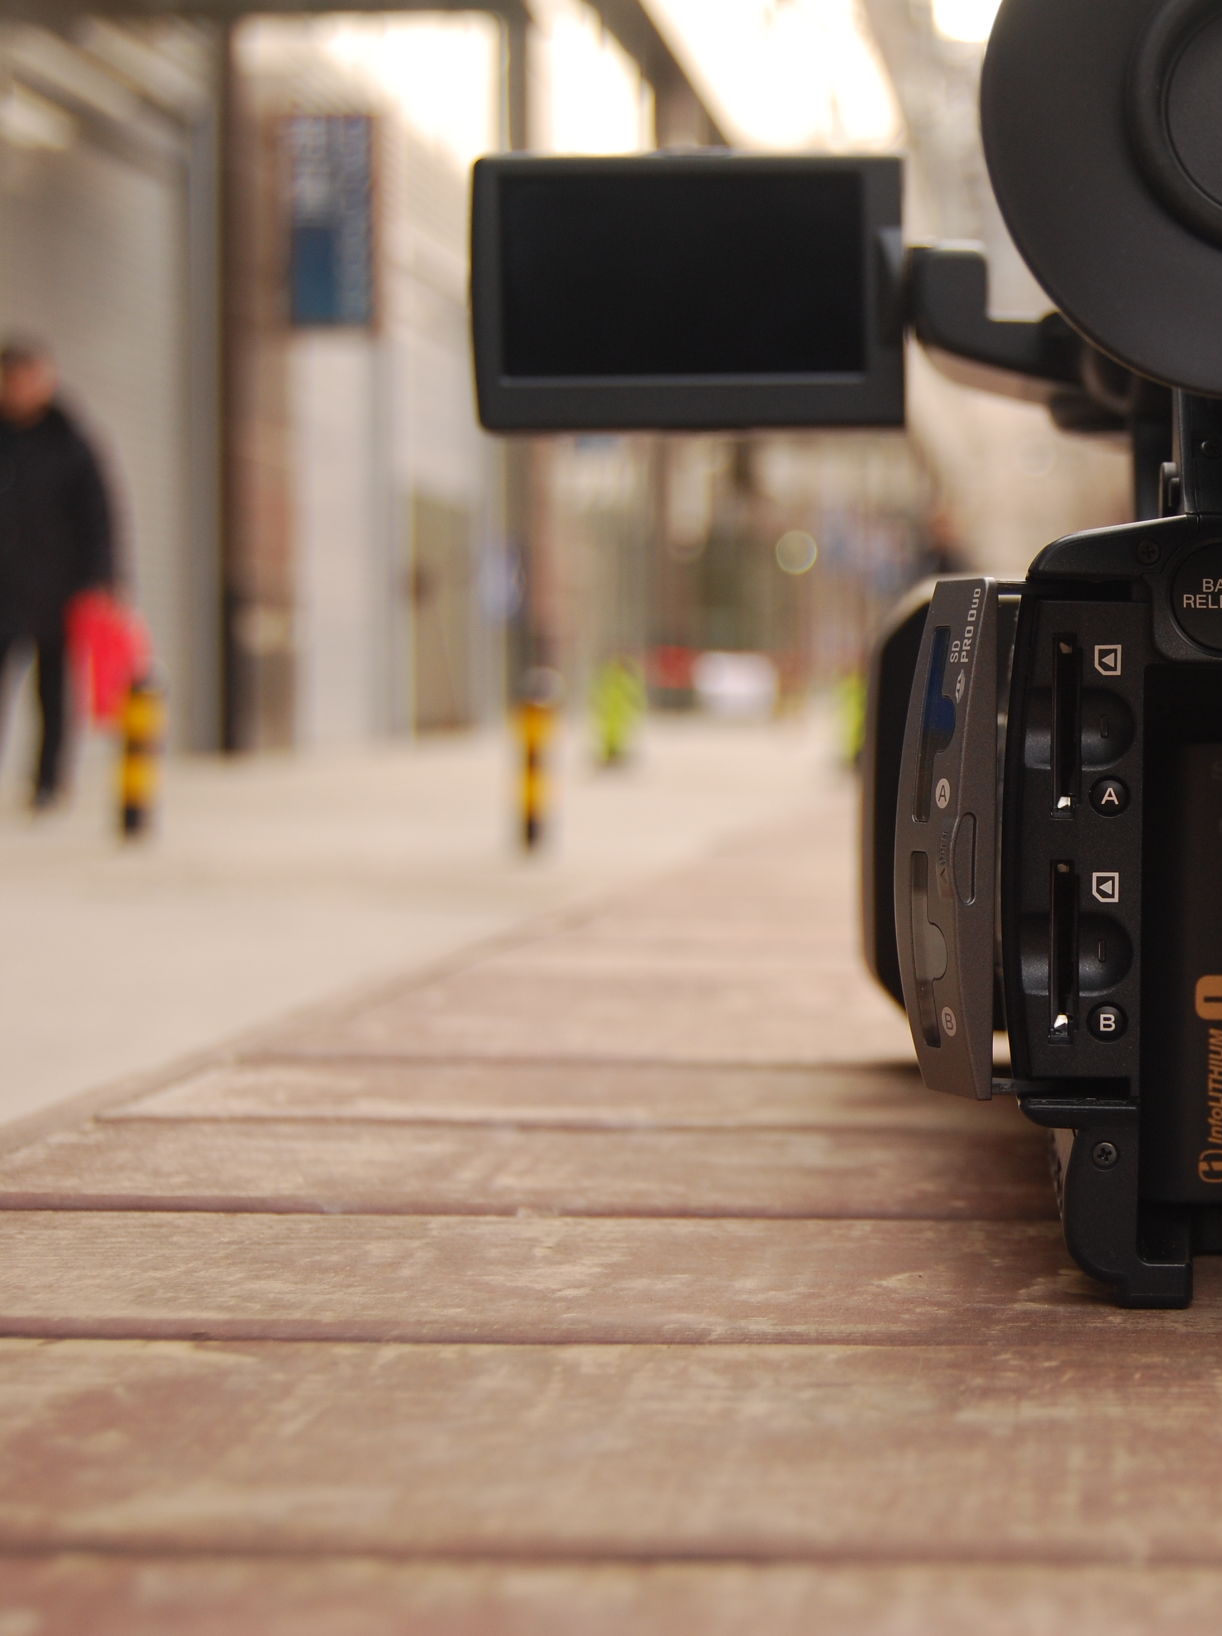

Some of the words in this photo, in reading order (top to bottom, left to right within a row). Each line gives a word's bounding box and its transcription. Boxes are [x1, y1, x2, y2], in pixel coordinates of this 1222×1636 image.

[949, 640, 961, 663] SD
[960, 625, 974, 663] PRO
[1101, 787, 1120, 805] A
[1099, 1013, 1116, 1031] B
